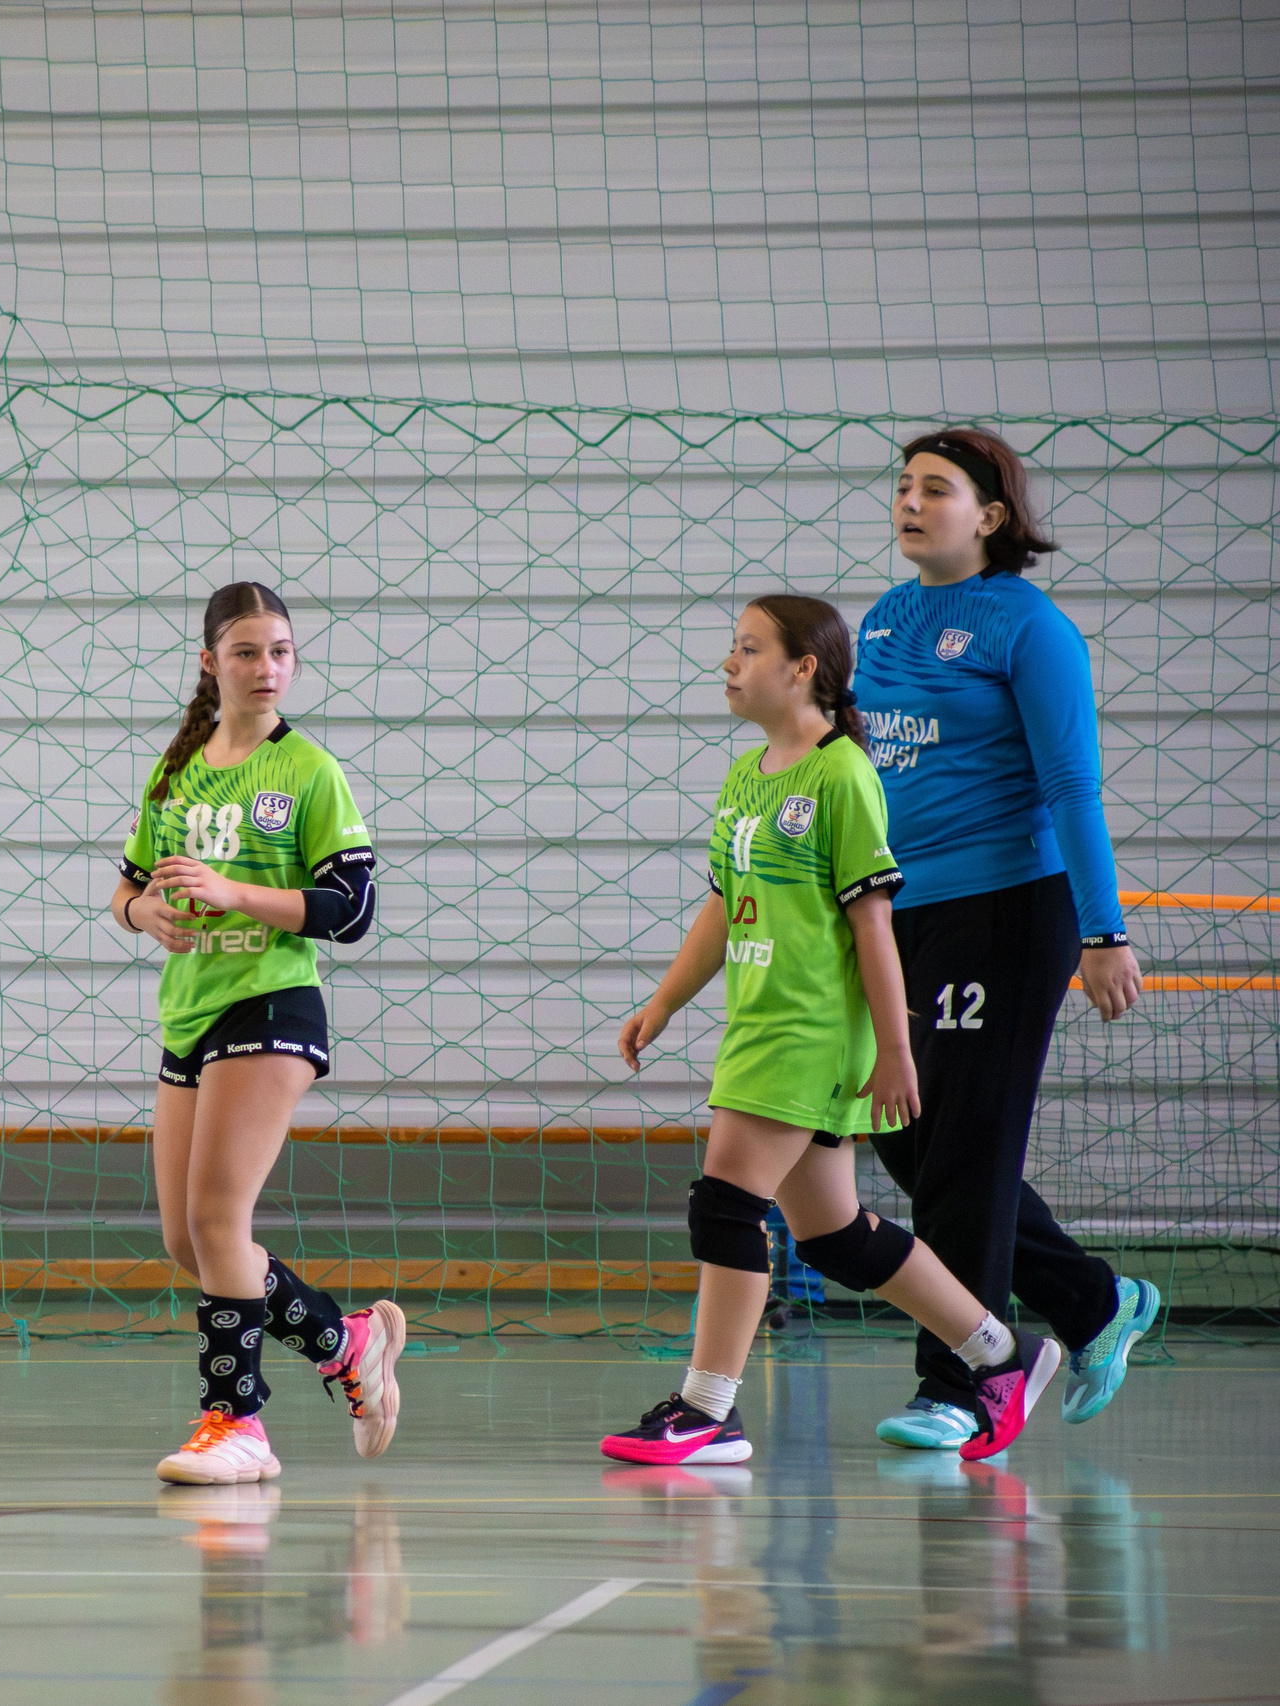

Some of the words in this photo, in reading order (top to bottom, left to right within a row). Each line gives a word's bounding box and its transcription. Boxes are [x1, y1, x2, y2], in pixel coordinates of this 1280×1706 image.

[261, 796, 288, 810] CSO
[789, 800, 812, 814] CSO
[185, 803, 243, 861] 88
[732, 815, 762, 872] 11
[341, 851, 373, 863] Kempa
[839, 885, 863, 905] Kempa
[870, 872, 903, 887] Kempa
[936, 982, 986, 1029] 12
[227, 1042, 262, 1054] Kempa
[273, 1039, 304, 1053] Kempa
[161, 1067, 187, 1083] Kempa
